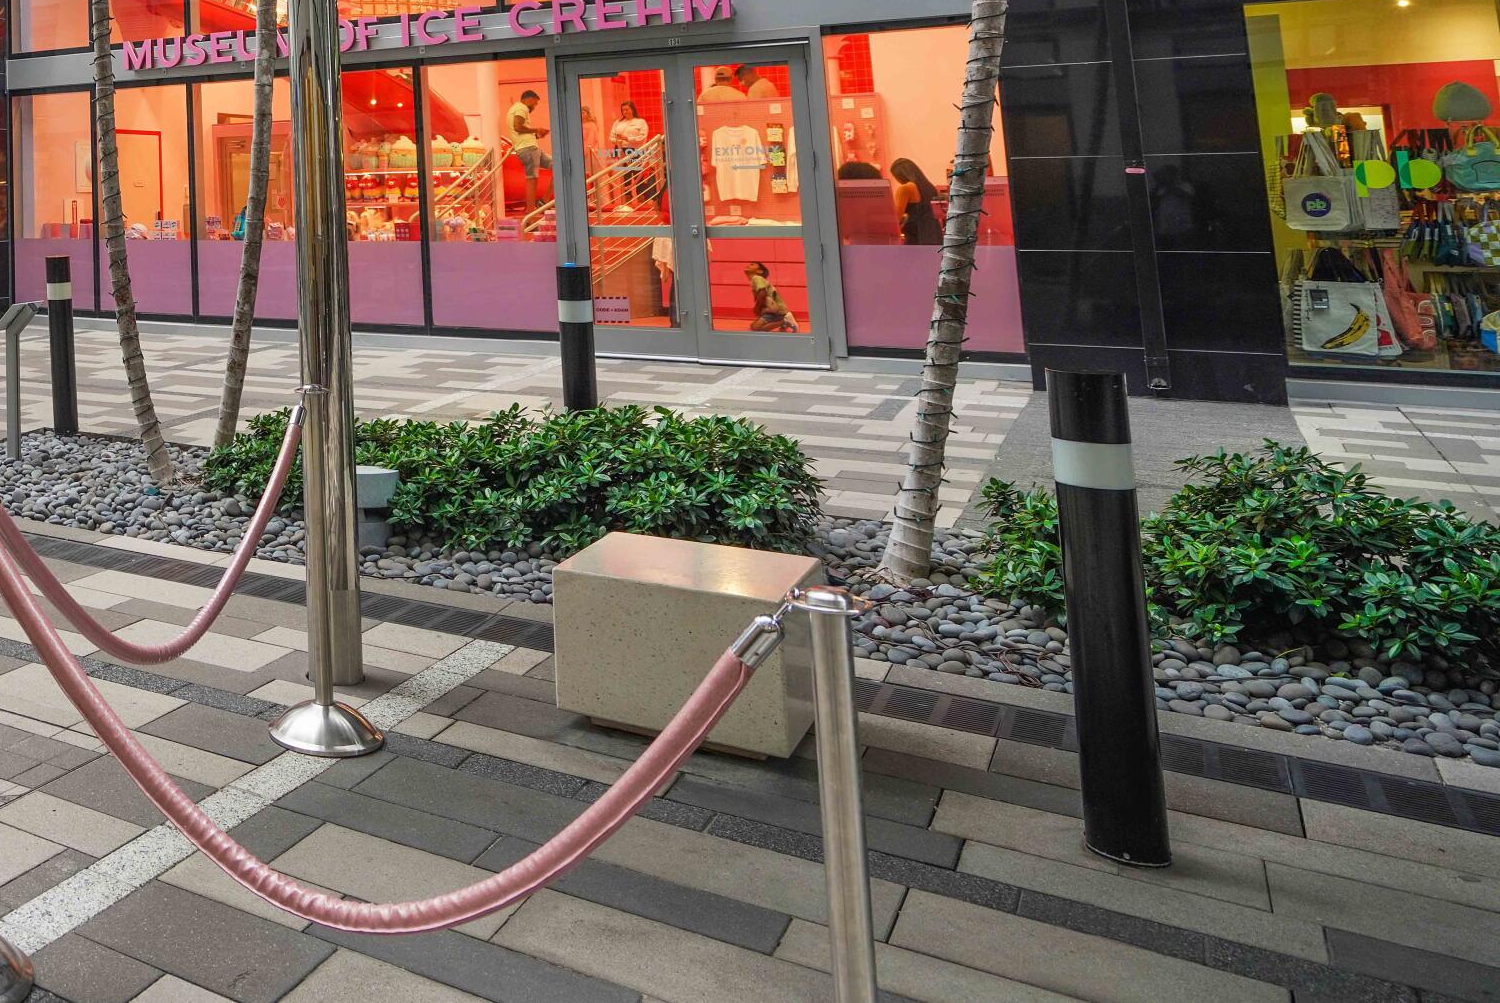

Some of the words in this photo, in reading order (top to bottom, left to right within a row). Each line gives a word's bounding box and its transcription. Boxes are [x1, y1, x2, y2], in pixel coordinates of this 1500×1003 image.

[122, 27, 289, 71] MUSEU
[400, 5, 485, 47] ICE
[715, 146, 740, 156] EXIT
